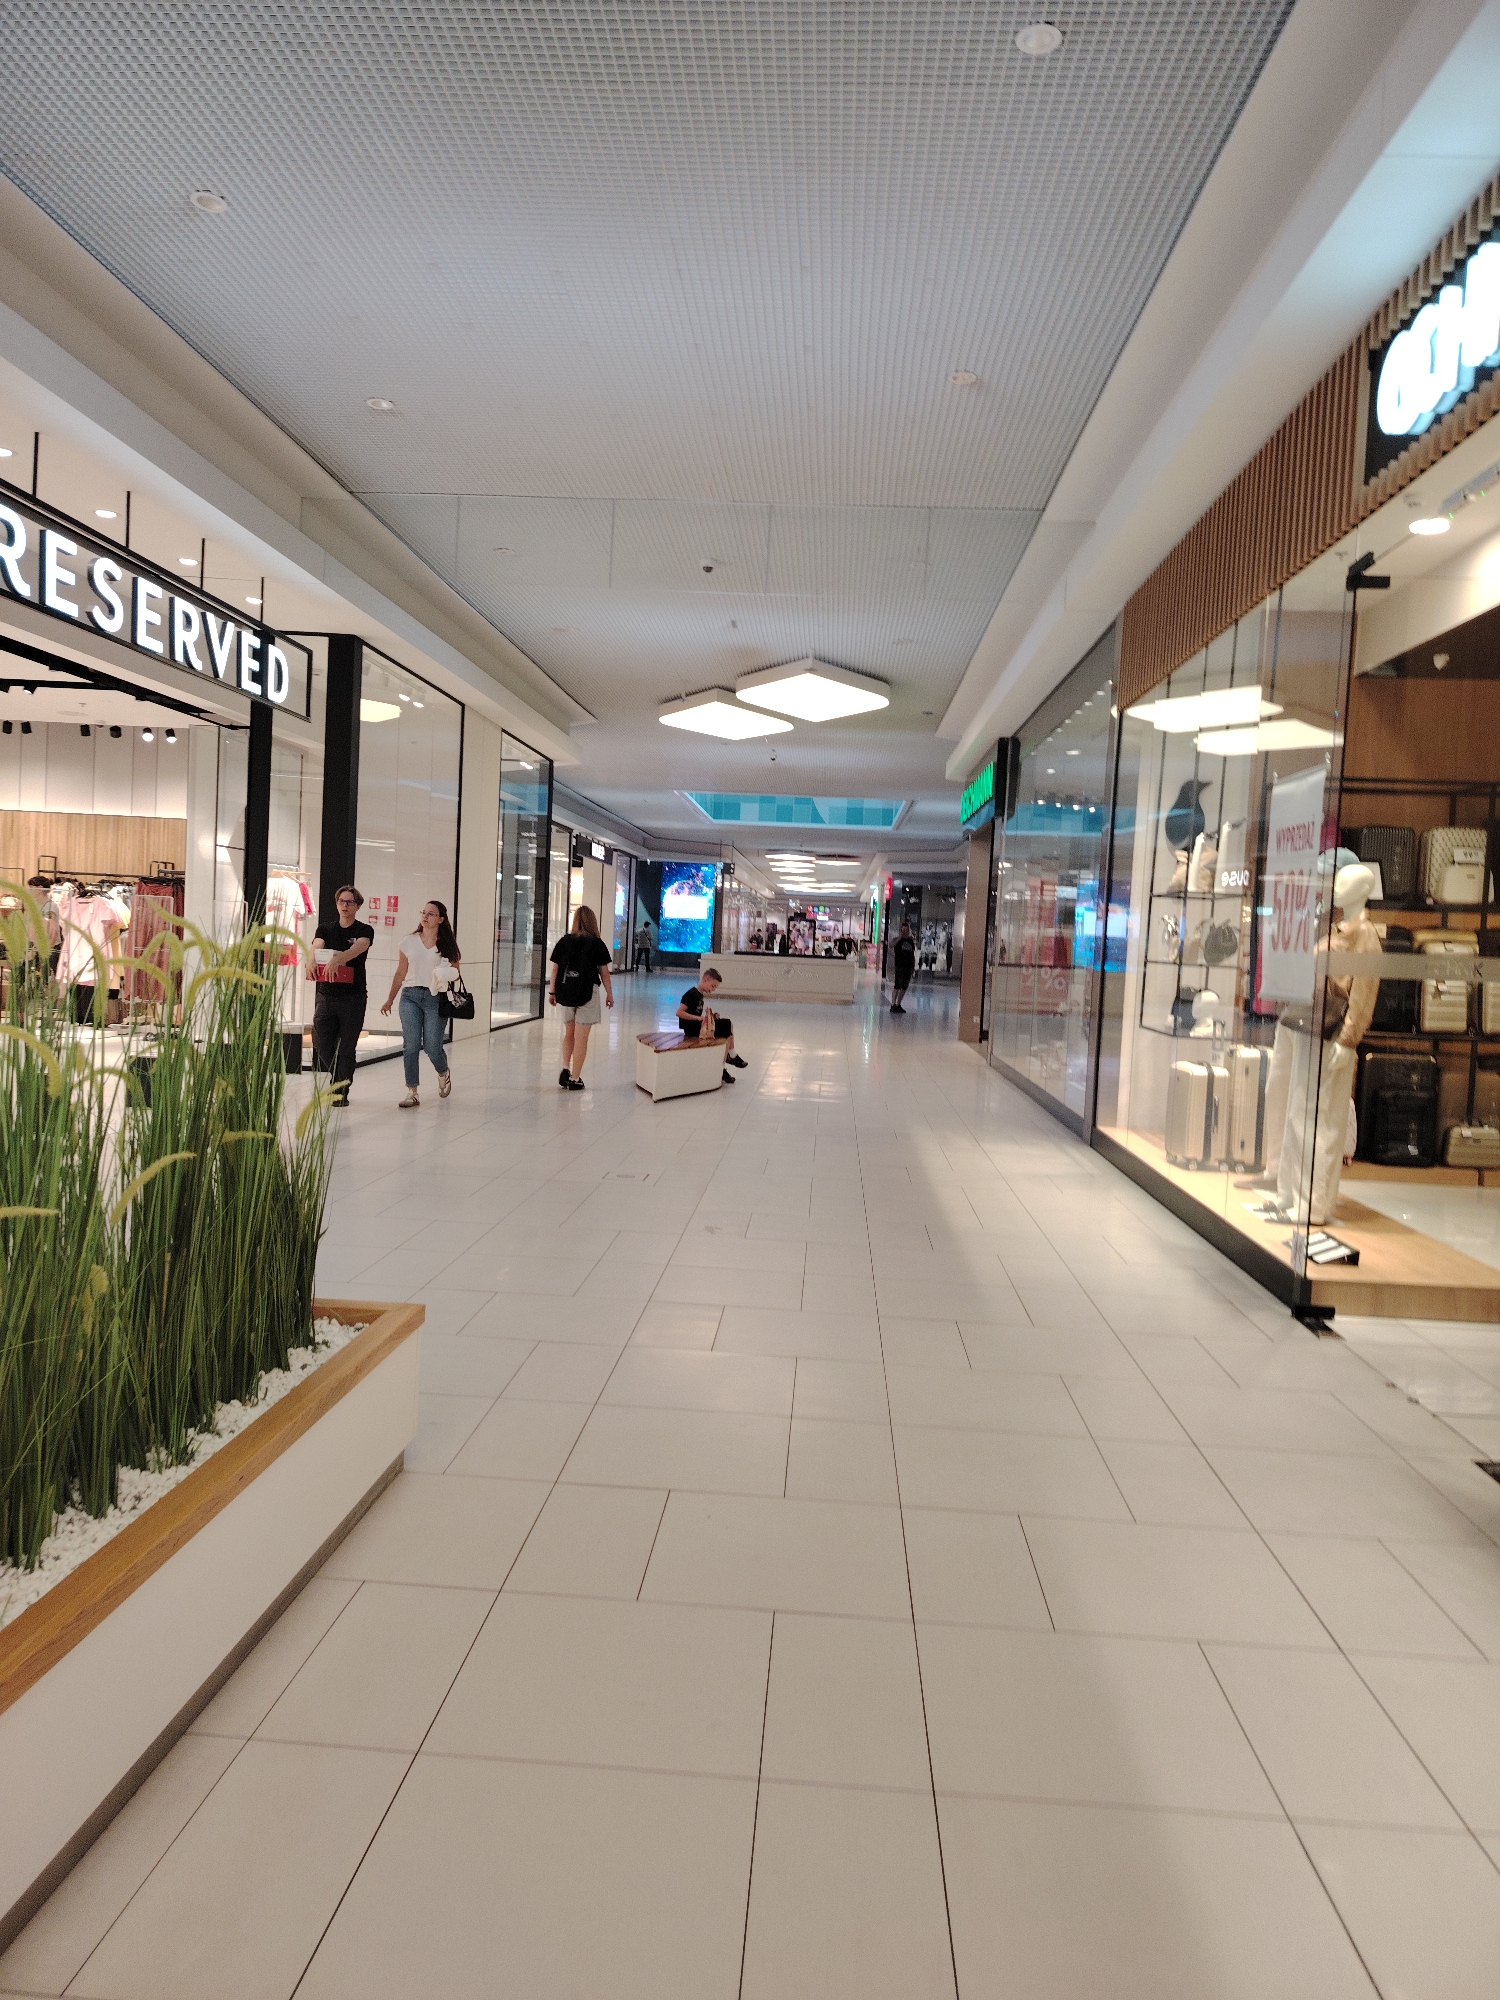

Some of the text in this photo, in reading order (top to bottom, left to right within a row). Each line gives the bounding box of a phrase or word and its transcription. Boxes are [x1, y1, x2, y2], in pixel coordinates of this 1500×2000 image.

[0, 503, 289, 704] RESERVED
[1275, 814, 1315, 856] WYPRZEDAŻ
[1271, 868, 1311, 953] 50%
